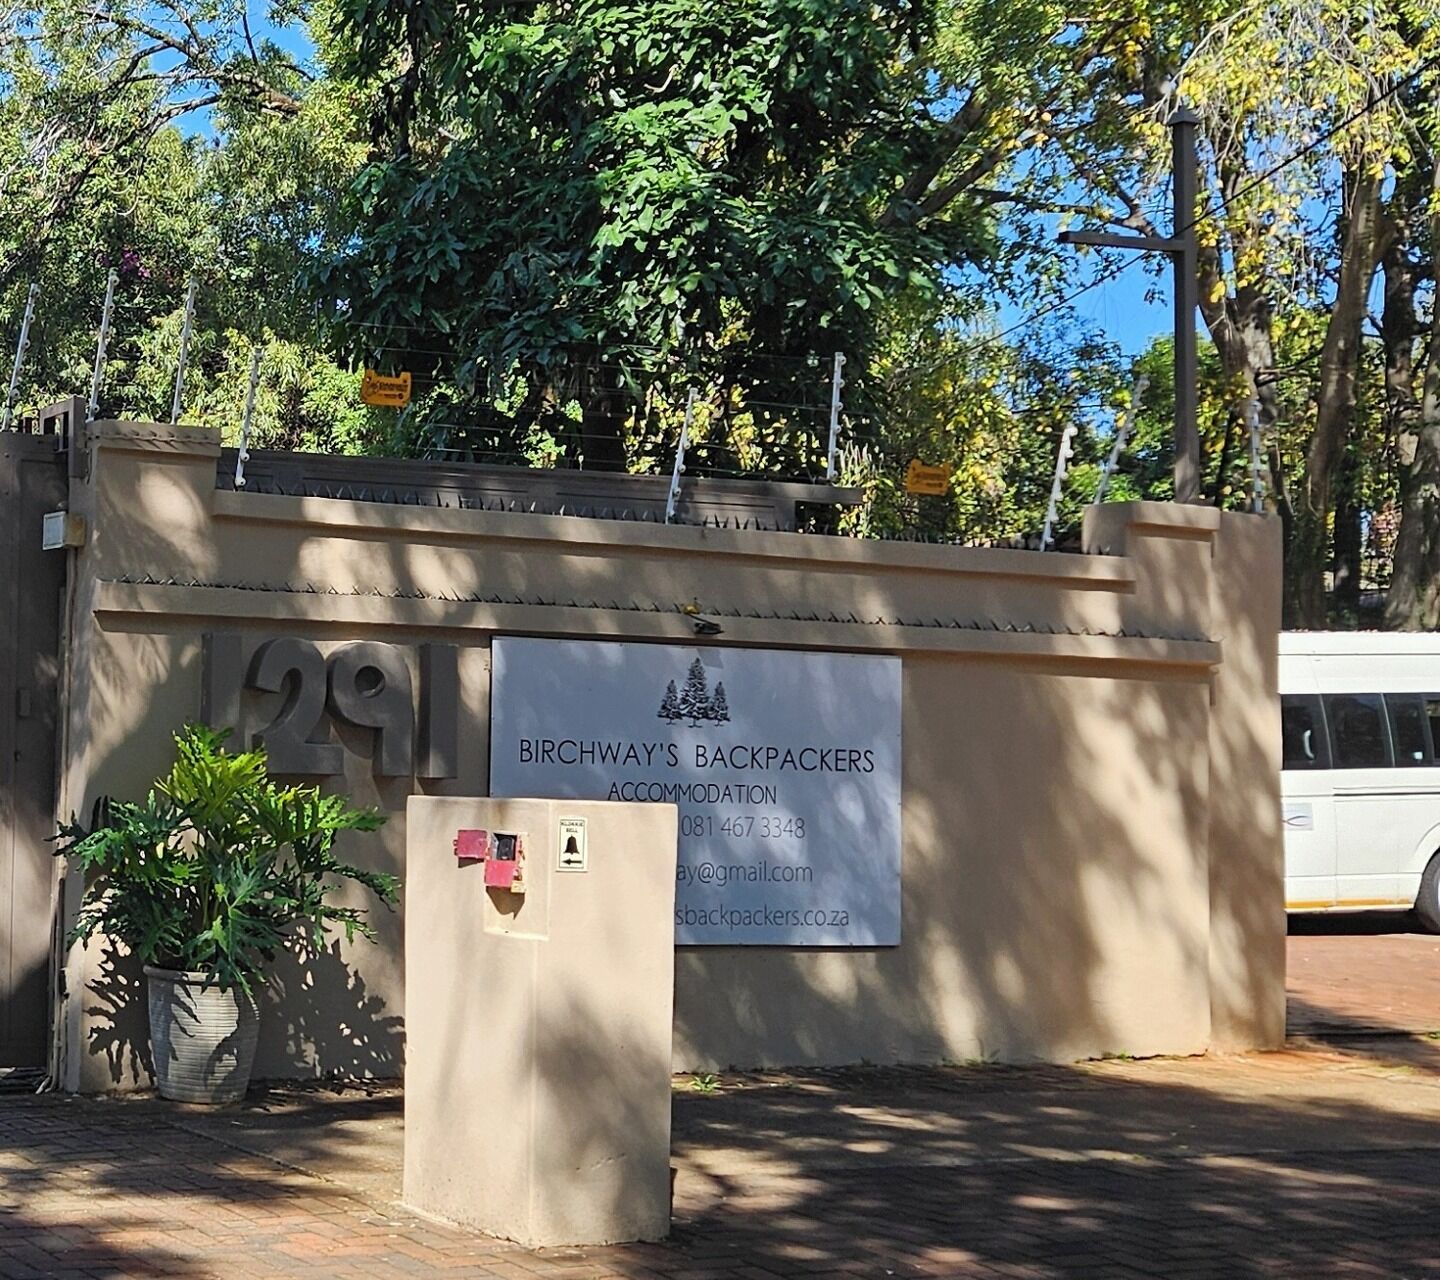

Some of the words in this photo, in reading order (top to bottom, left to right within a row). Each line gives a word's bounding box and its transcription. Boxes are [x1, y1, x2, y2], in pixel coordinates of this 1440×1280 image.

[201, 632, 459, 780] 1291
[519, 739, 679, 768] BIRCHWAY'S
[695, 744, 875, 774] BACKPACKERS
[608, 781, 777, 805] ACCOMMODATION
[681, 815, 713, 837] 081
[720, 816, 755, 838] 467
[760, 816, 806, 839] 3348
[676, 860, 813, 887] ay@gmail.com
[674, 904, 850, 931] sbackpackers.co.za
